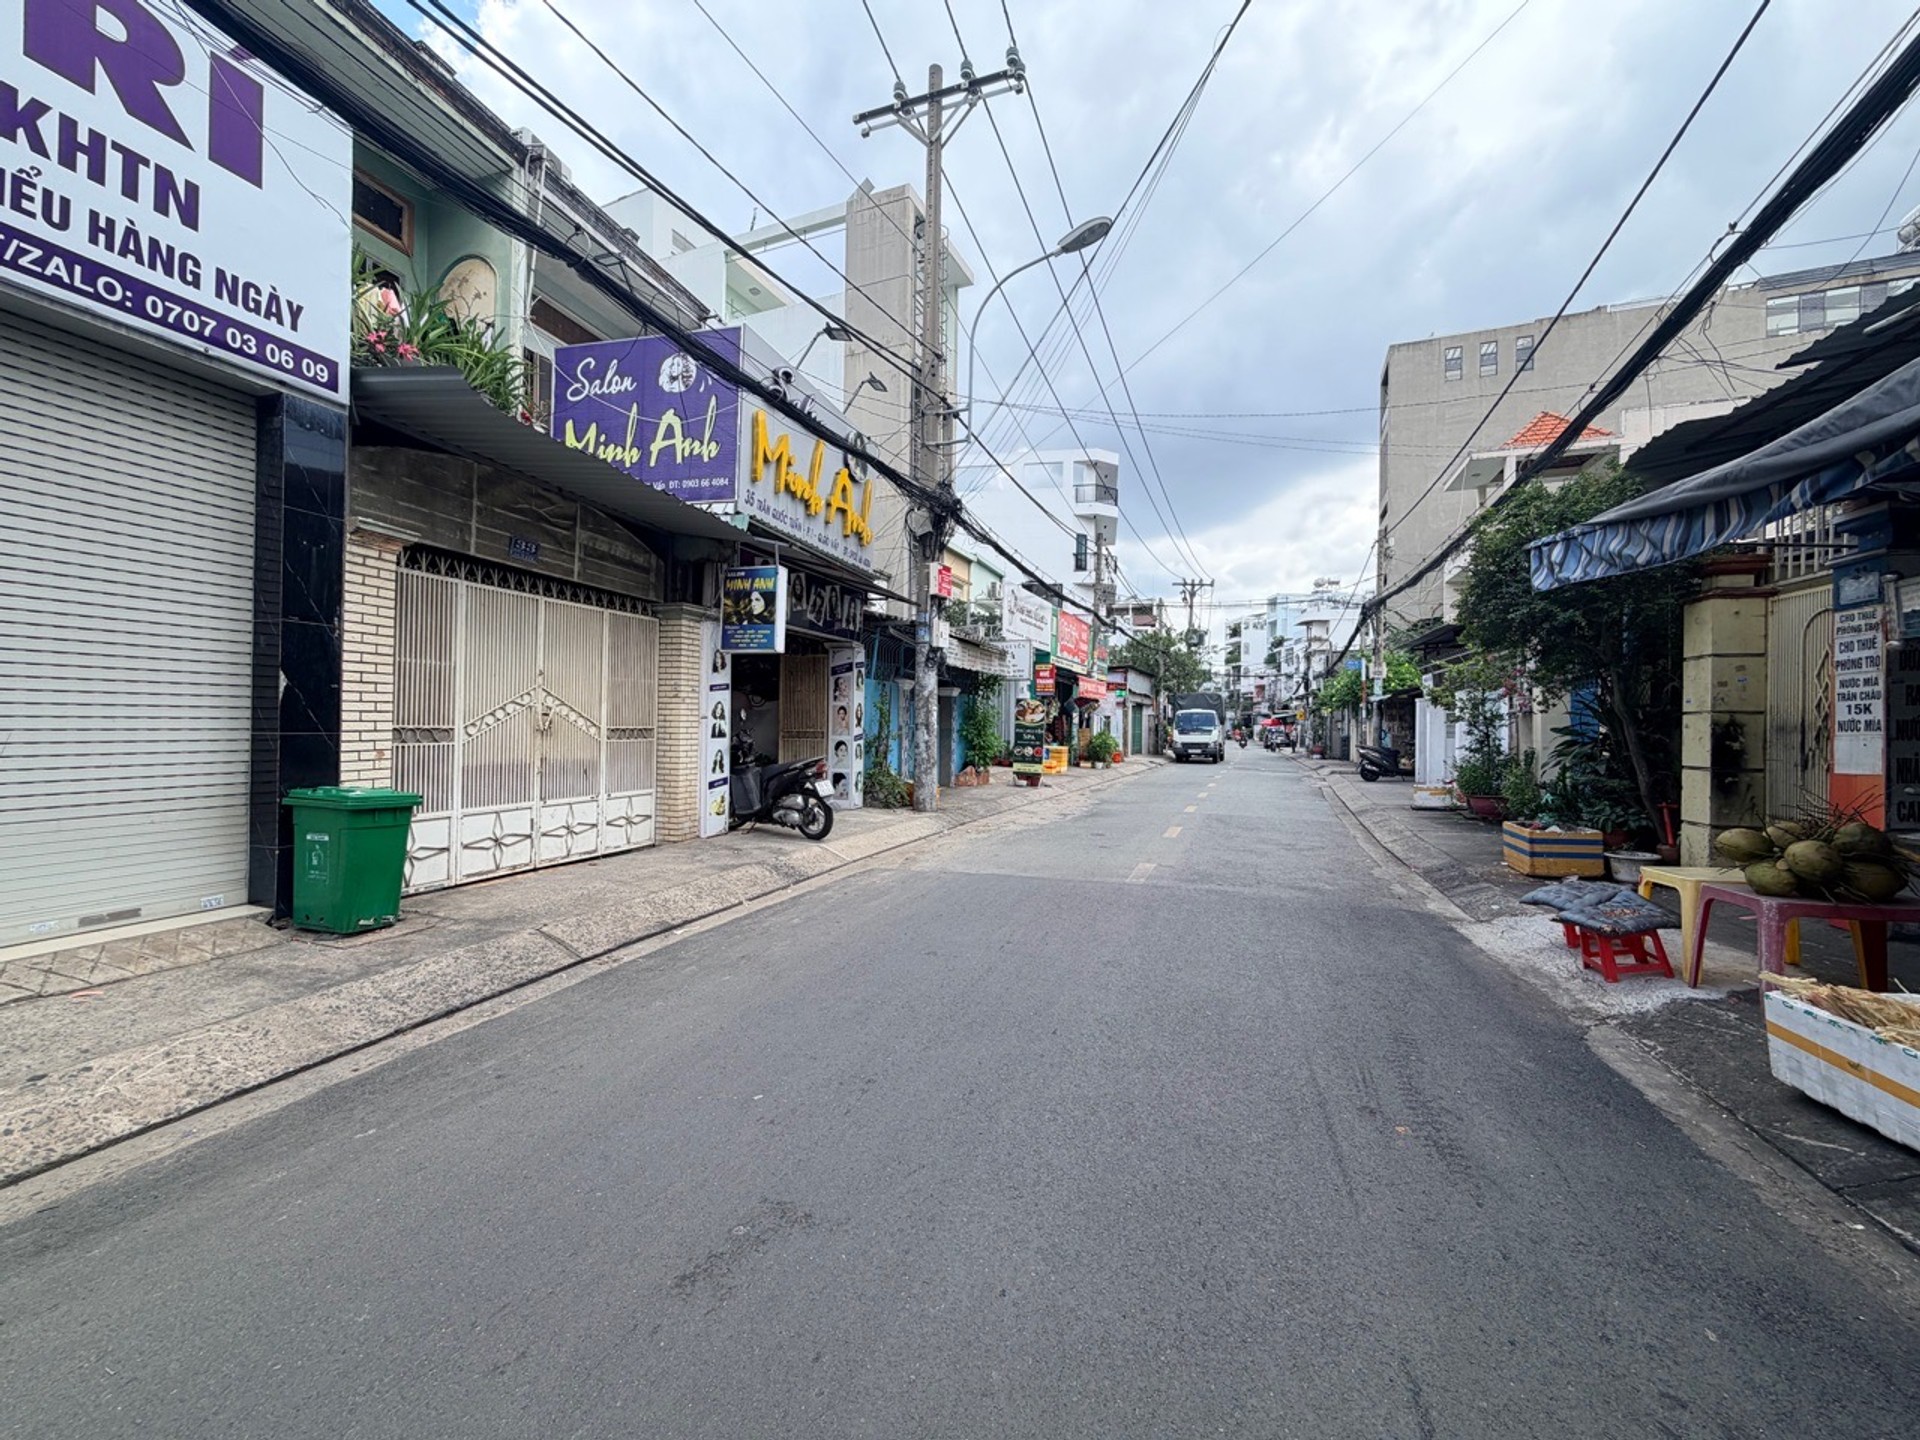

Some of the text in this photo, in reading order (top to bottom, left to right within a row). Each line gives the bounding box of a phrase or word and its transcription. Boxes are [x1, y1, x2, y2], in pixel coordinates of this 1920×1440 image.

[88, 208, 201, 291] HÀNG
[215, 266, 304, 333] NGÀY
[0, 234, 329, 383] /ZALO: 0707 03 06 09
[566, 357, 637, 402] Salon
[565, 402, 642, 468] Minh
[650, 394, 721, 468] Anh
[682, 478, 699, 488] 0903
[701, 478, 710, 487] 66
[711, 477, 729, 486] 4084
[751, 409, 874, 547] Minh Anh
[744, 489, 756, 507] 35
[1839, 613, 1855, 624] CHO
[1839, 635, 1877, 654] CHO THUÊ
[1836, 655, 1881, 672] PHÒNG TRỌ
[1846, 703, 1873, 715] 15K
[1837, 717, 1861, 733] NƯỚC
